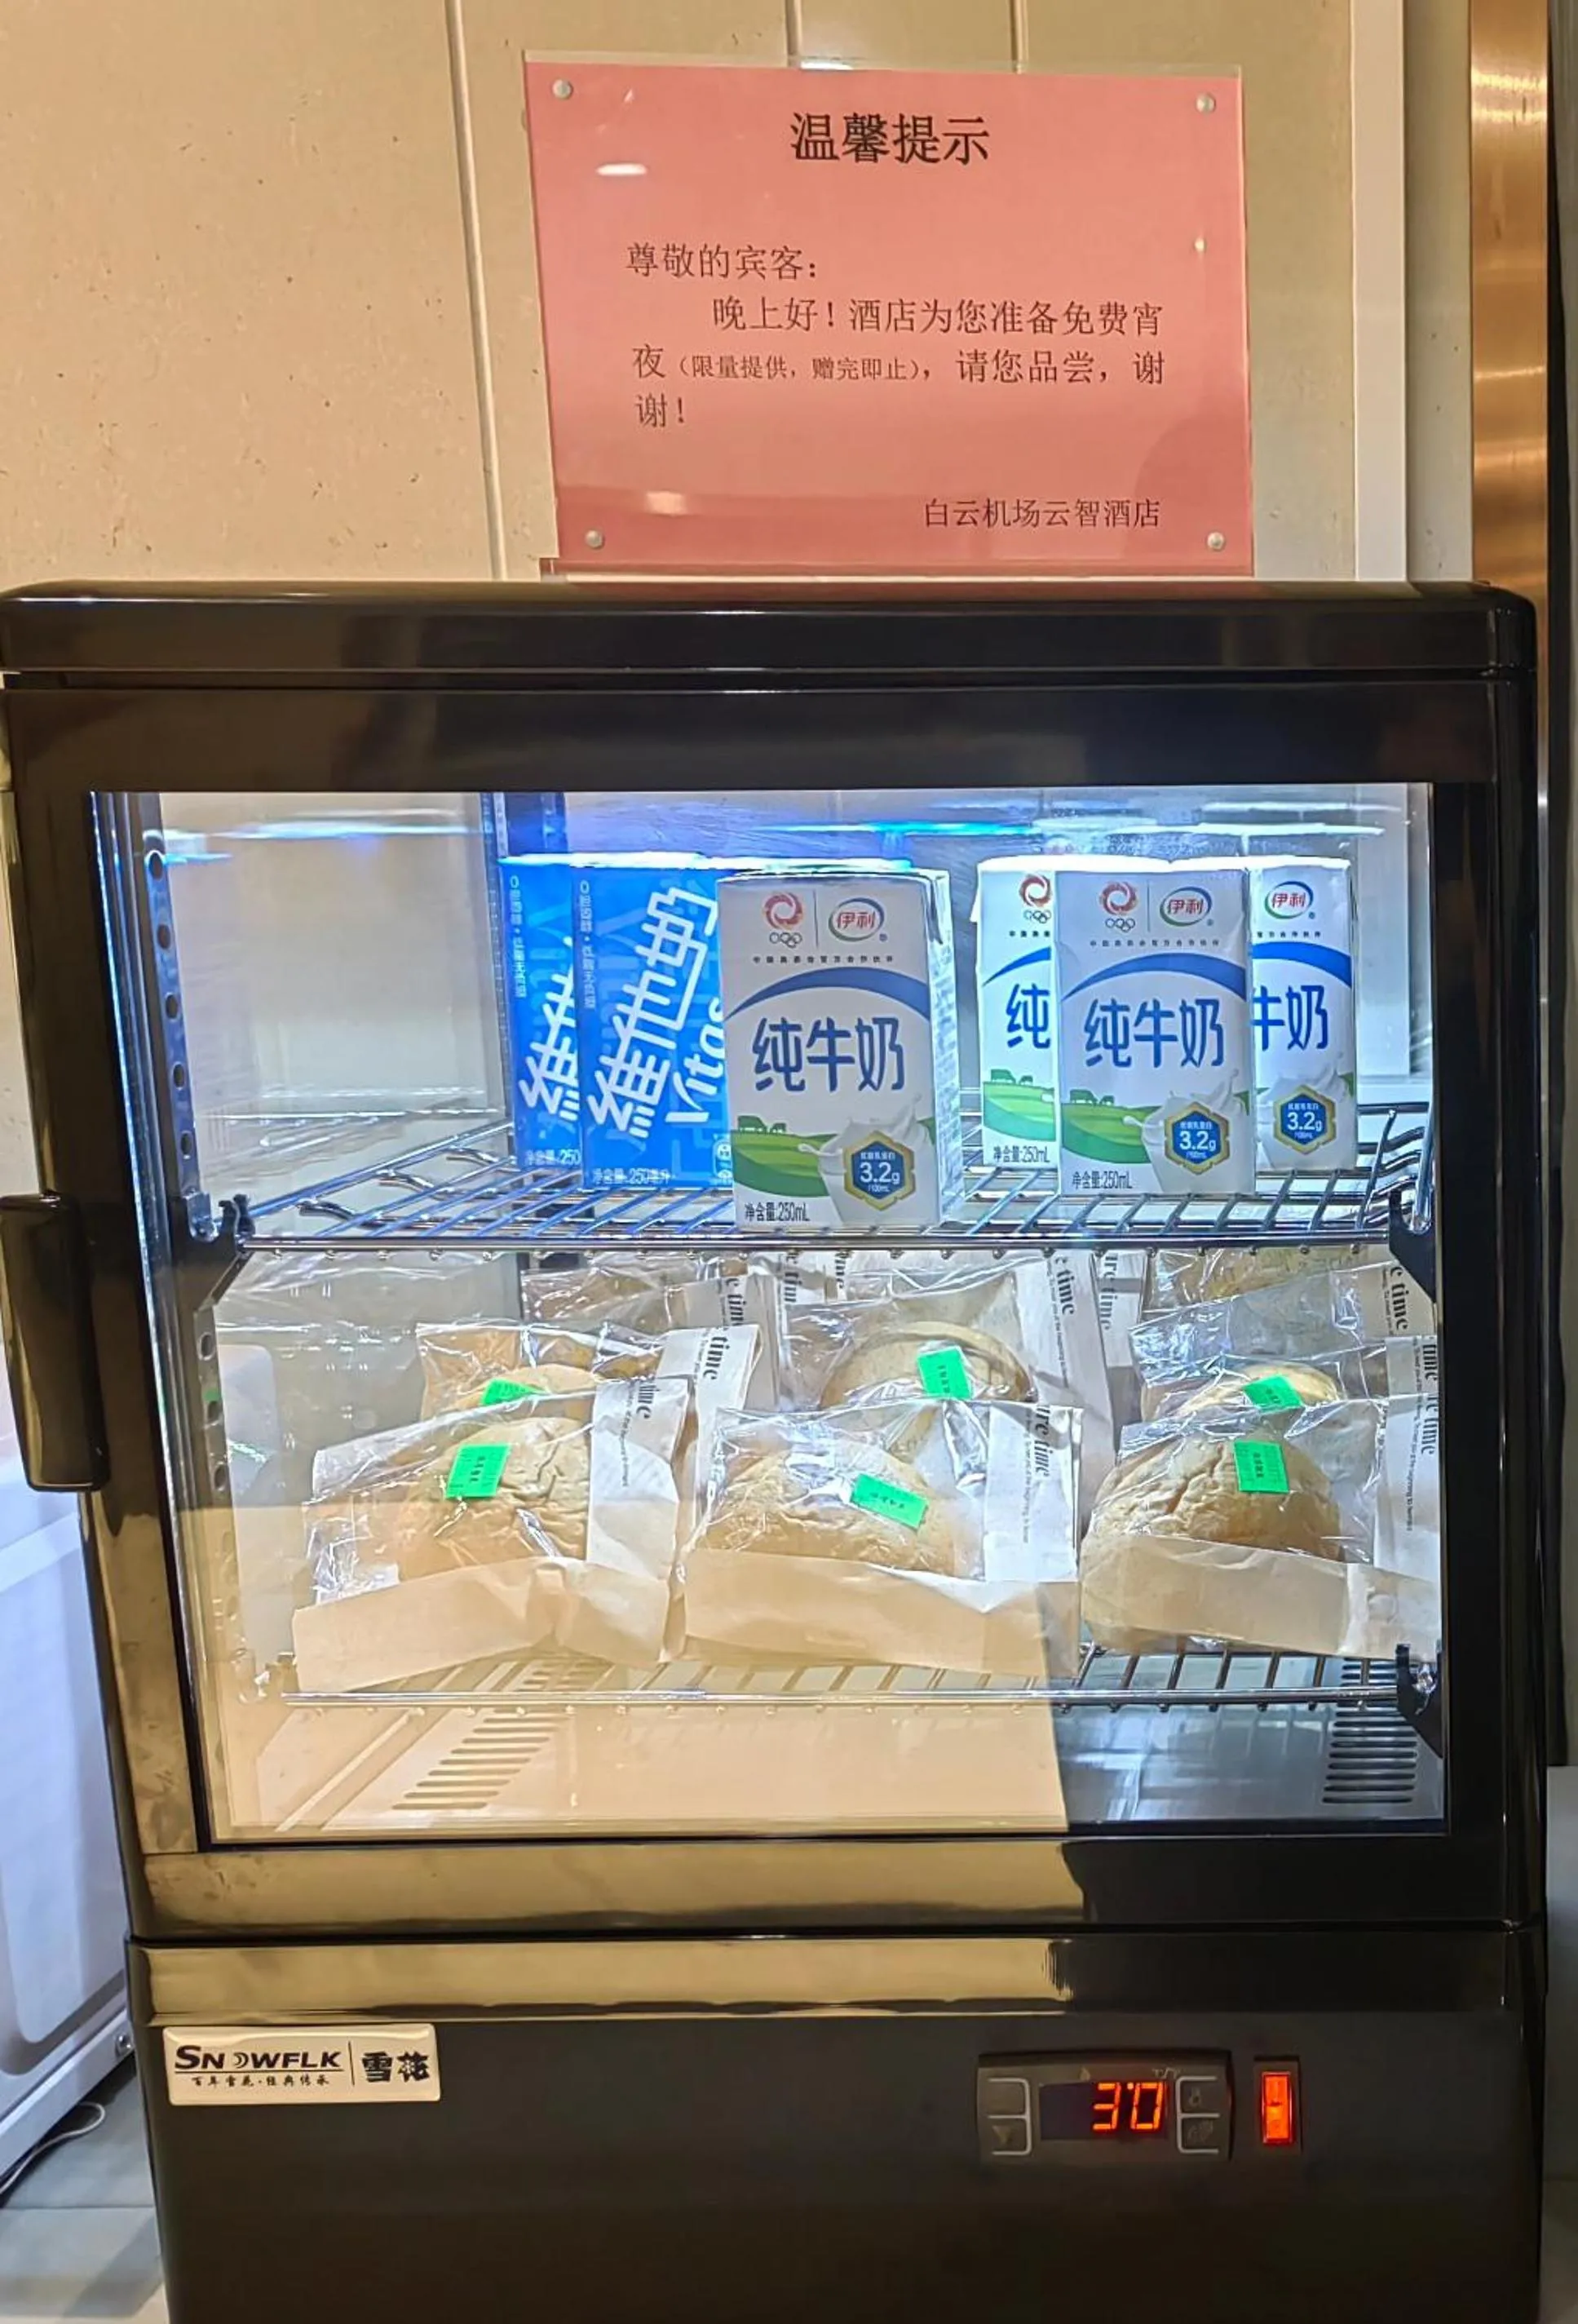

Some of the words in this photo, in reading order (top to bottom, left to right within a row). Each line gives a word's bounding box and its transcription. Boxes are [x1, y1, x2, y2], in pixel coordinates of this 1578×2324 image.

[790, 113, 990, 166] 温馨提示
[925, 499, 1160, 529] 白云机场云智酒店
[1167, 900, 1204, 915] 伊利
[1271, 892, 1306, 909] 伊利
[837, 911, 876, 929] 伊利
[1083, 998, 1225, 1069] 纯牛奶
[752, 1016, 905, 1093] 纯牛奶
[1287, 1112, 1323, 1131] 3.2g
[1179, 1131, 1217, 1151] 3.2g
[860, 1162, 901, 1184] 3.2g
[1056, 1270, 1076, 1315] time
[1391, 1283, 1410, 1330] time
[703, 1336, 730, 1380] time
[1034, 1438, 1054, 1477] time
[362, 2051, 431, 2083] 雪花
